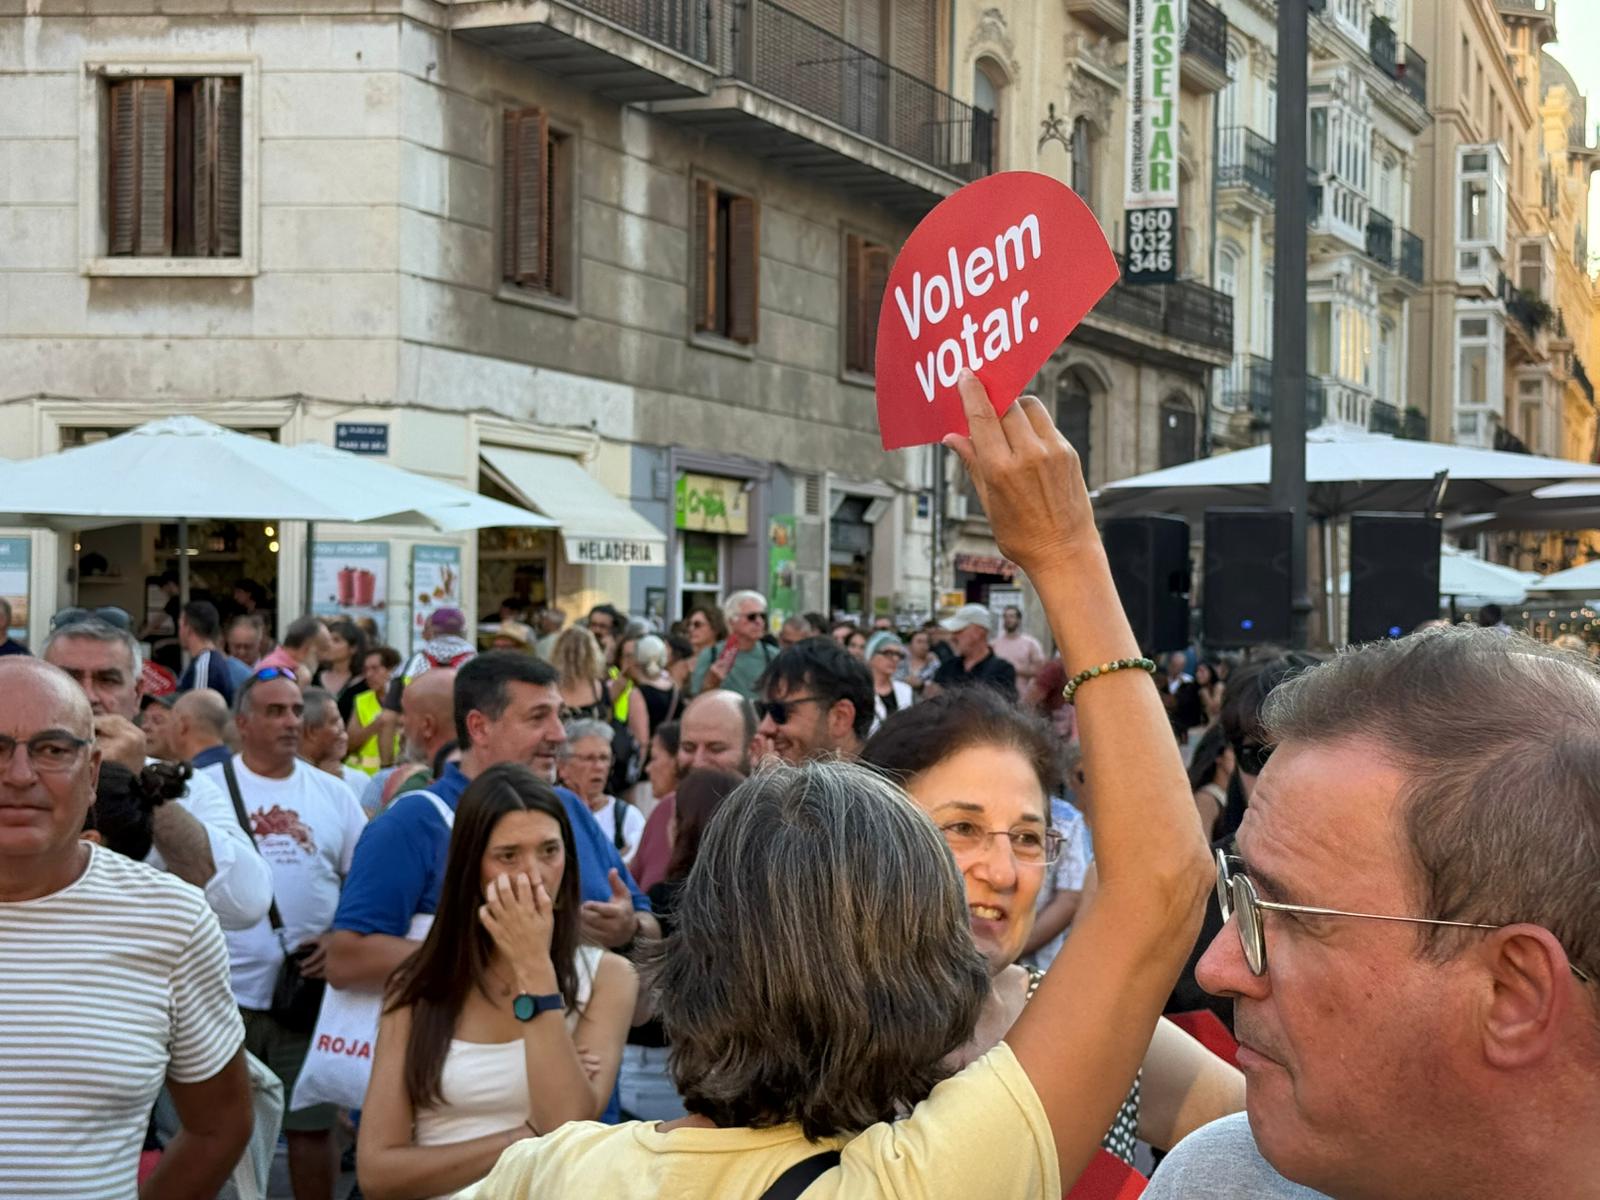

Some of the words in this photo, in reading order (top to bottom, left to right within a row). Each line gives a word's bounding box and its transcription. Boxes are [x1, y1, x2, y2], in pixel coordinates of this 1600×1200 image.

[1148, 0, 1175, 192] ASEJAR
[1130, 209, 1172, 232] 960
[1130, 231, 1172, 252] 032
[1129, 251, 1172, 273] 346
[895, 214, 1041, 340] Volem
[915, 290, 1039, 403] votar.
[578, 541, 651, 561] HELADERIA
[317, 1034, 370, 1058] ROJA
